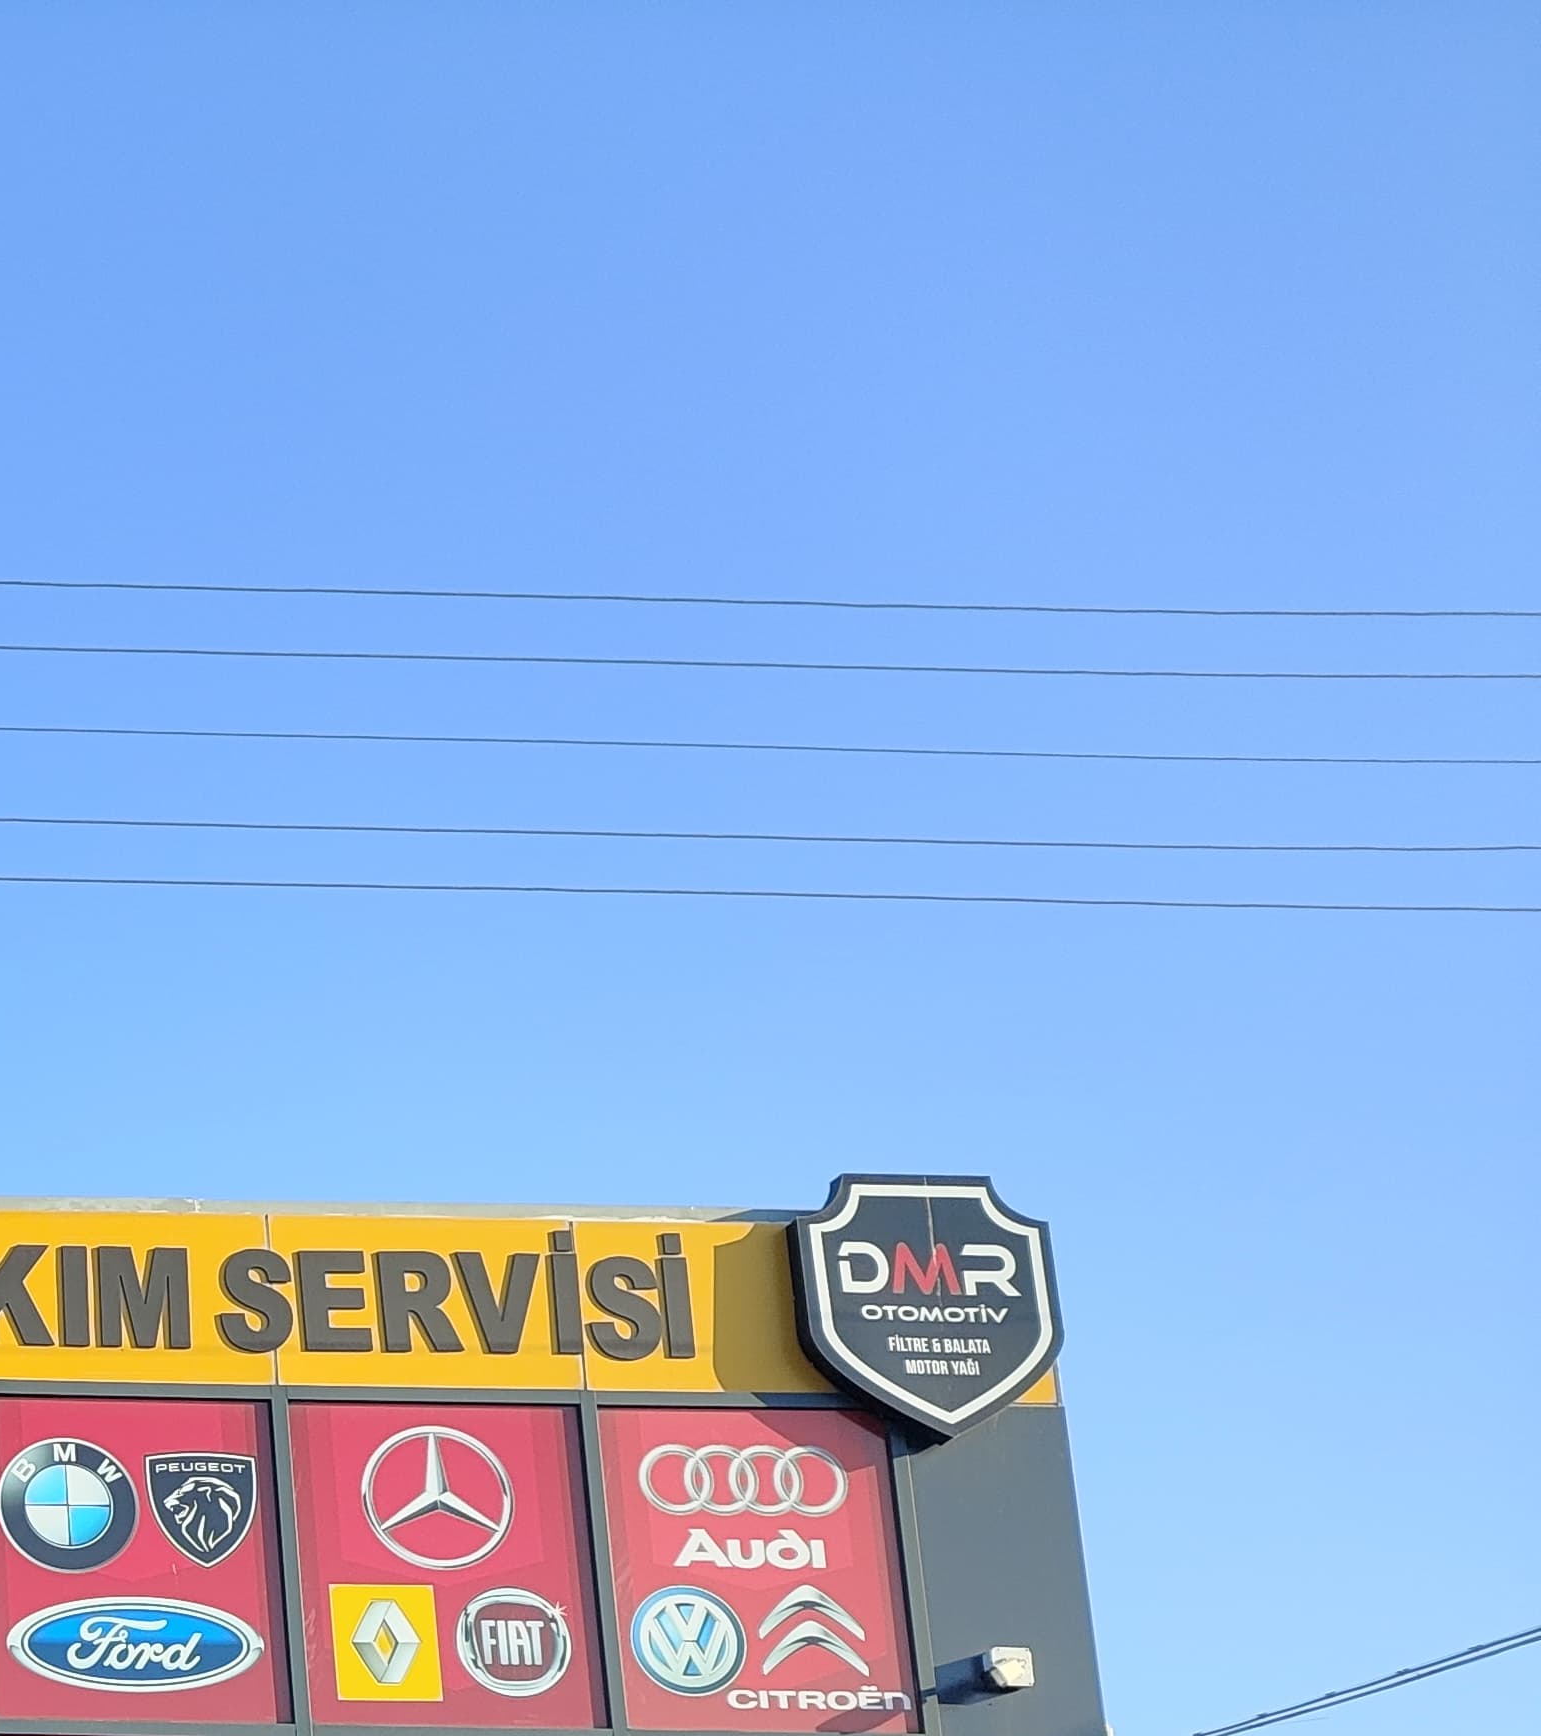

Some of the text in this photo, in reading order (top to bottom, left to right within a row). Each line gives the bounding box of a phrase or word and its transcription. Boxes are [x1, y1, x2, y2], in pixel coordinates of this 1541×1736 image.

[837, 1241, 1023, 1297] DMR
[214, 1229, 696, 1361] SERVİSİ
[861, 1304, 1009, 1324] OTOMOTİV
[888, 1334, 991, 1354] FİLTRE & BALATA
[905, 1358, 981, 1376] MOTOR YAĞI
[10, 1443, 123, 1485] BMW
[155, 1462, 246, 1474] PEUGEOT
[673, 1528, 827, 1570] Audi
[67, 1616, 203, 1672] Ford
[480, 1619, 545, 1666] FIAT
[727, 1685, 911, 1711] CITROËN
